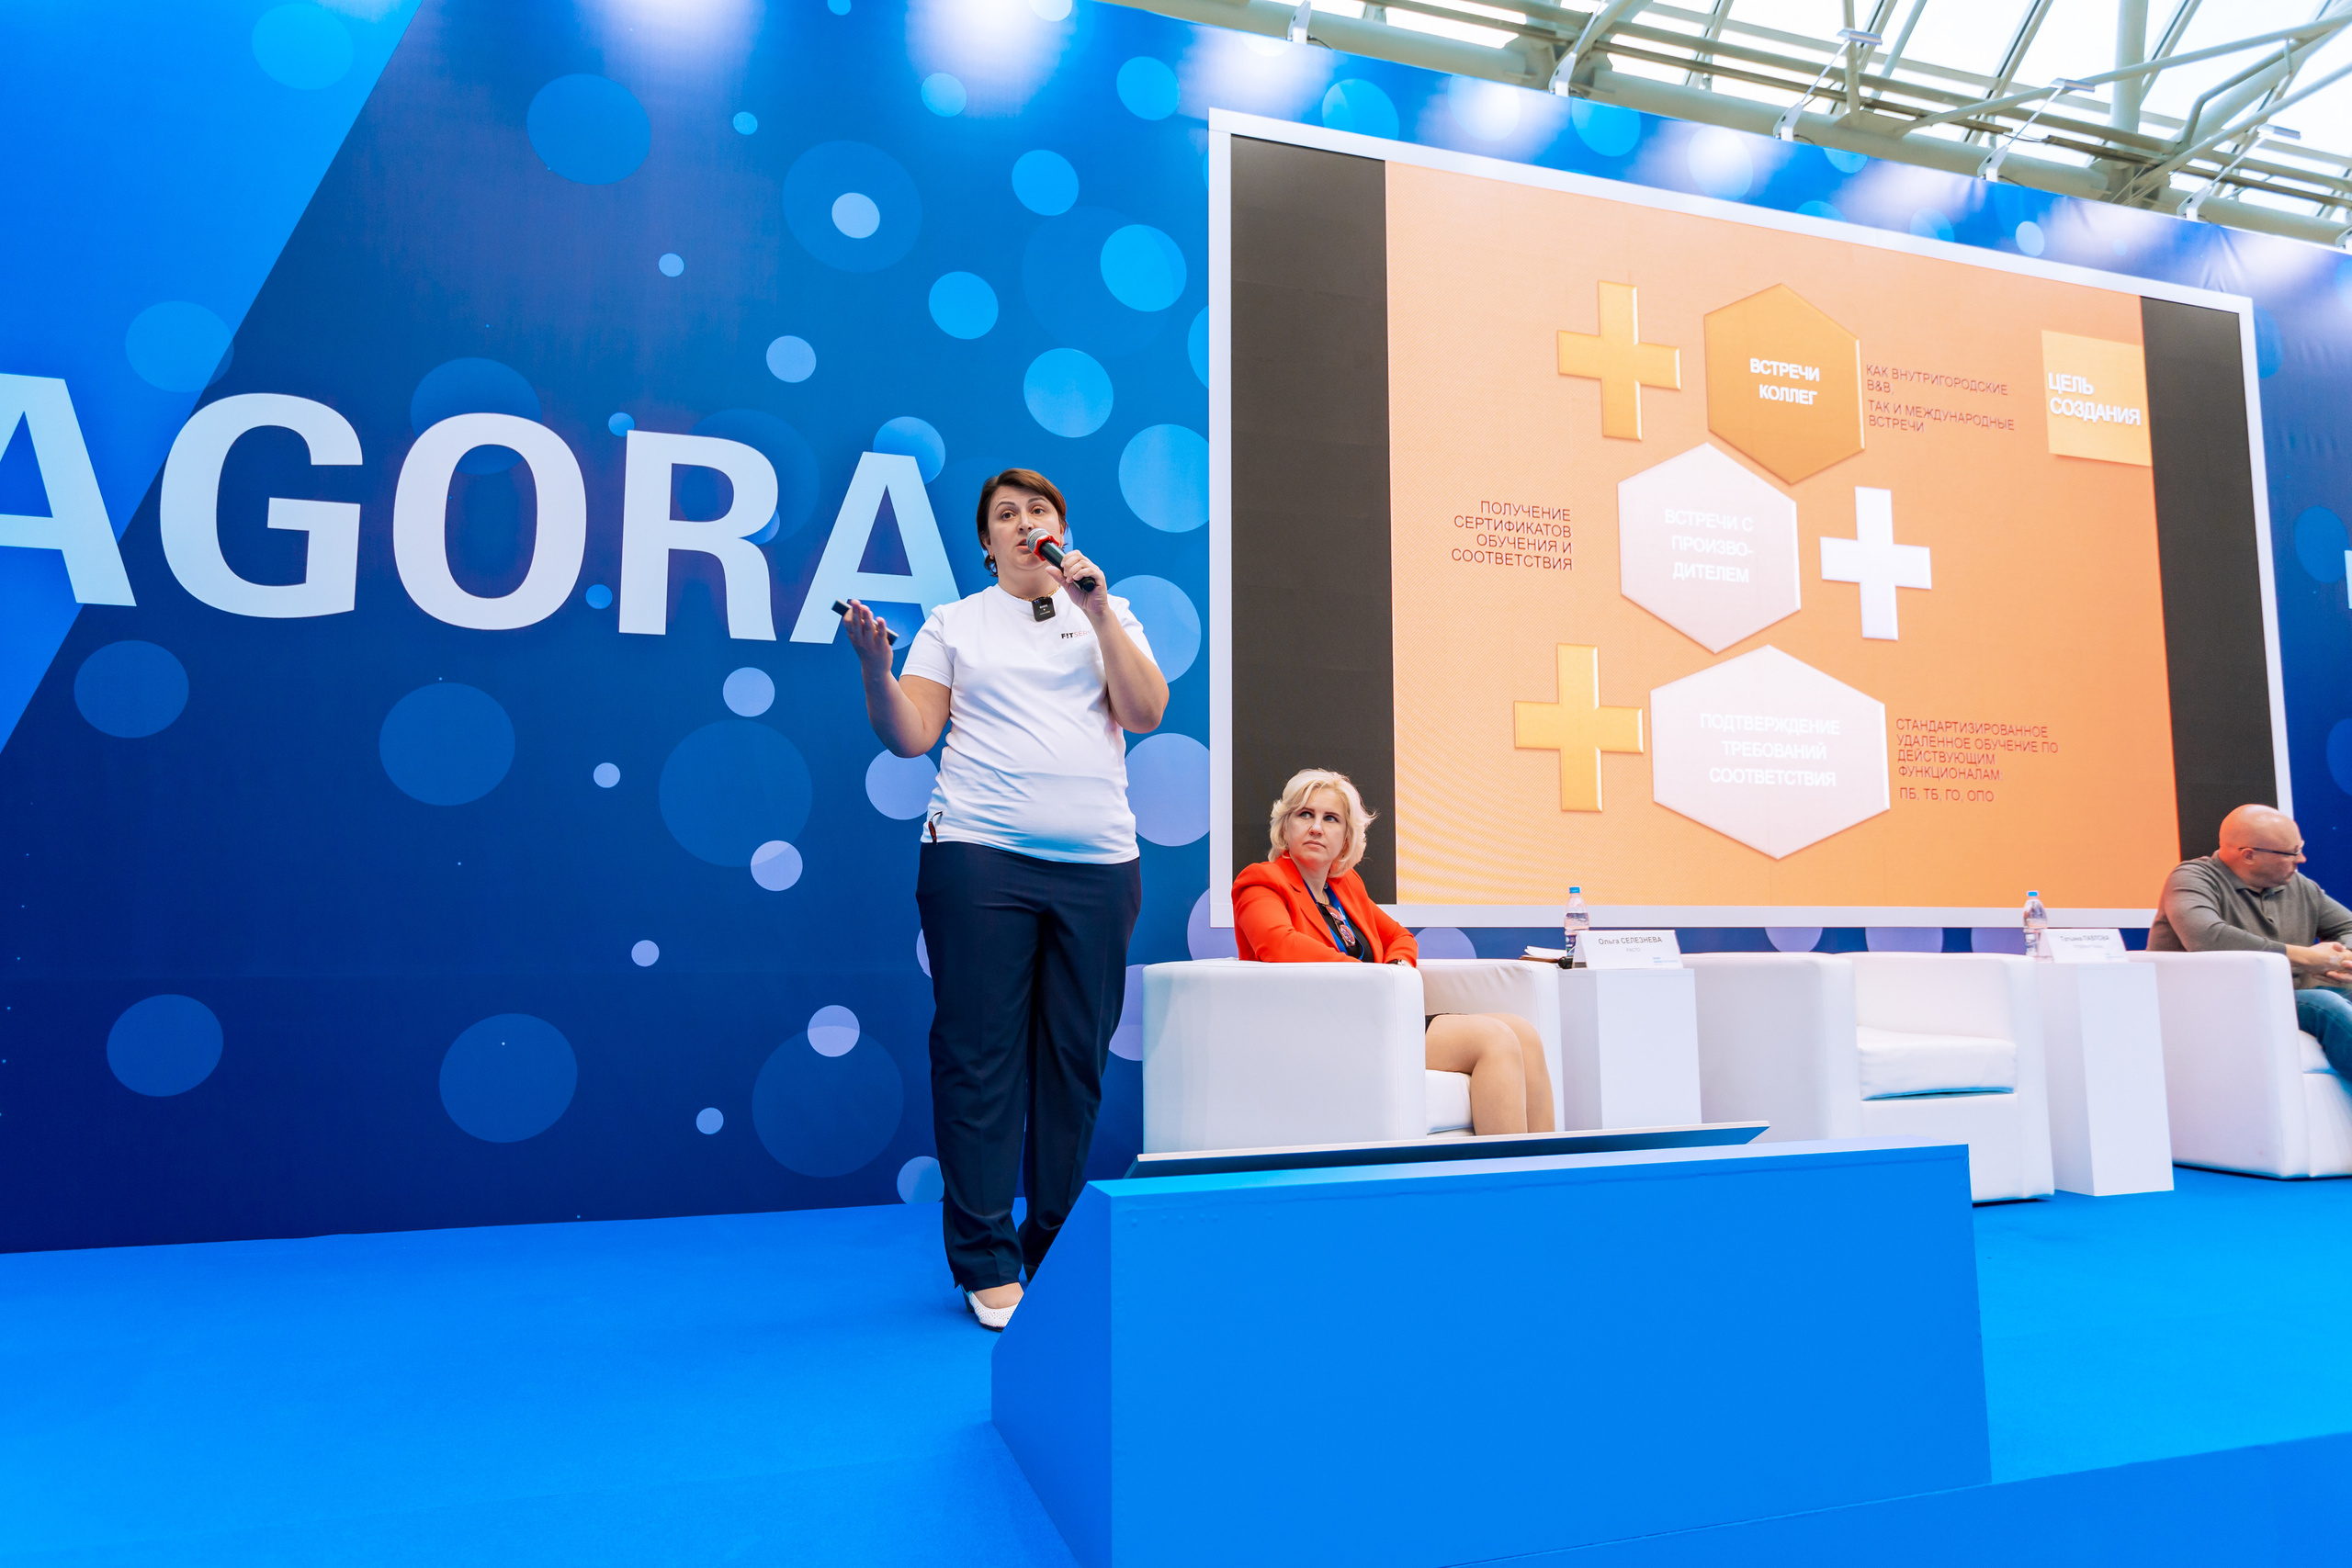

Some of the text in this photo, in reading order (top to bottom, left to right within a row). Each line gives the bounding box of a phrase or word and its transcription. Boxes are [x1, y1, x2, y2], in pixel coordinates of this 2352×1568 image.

[1749, 357, 1820, 382] ВСТРЕЧИ
[1866, 364, 2008, 396] КАК ВНУТРИГОРОДСКИЕ
[1758, 384, 1818, 405] КОЛЛЕГ
[2048, 372, 2095, 395] ЦЕЛЬ
[1868, 400, 2016, 432] ТАК И МЕЖДУНАРОДНЫЕ
[2050, 396, 2142, 426] СОЗДАНИЯ
[1869, 415, 1925, 433] ВСТРЕЧИ
[0, 372, 961, 646] AGORA
[1480, 500, 1571, 522] ПОЛУЧЕНИЕ
[1453, 514, 1572, 538] СЕРТИФИКАТОВ
[1664, 508, 1755, 533] ВСТРЕЧИ С
[1476, 533, 1572, 554] ОБУЧЕНИЯ И
[1671, 535, 1754, 558] ПРОИЗВО-
[1451, 547, 1573, 571] СООТВЕТСТВИЯ
[1672, 561, 1750, 583] ДИТЕЛЕМ
[1700, 713, 1841, 737] ПОДТВЕРЖДЕНИЕ
[1895, 717, 2049, 739] СТАНДАРТИЗИРОВАННОЕ
[1721, 739, 1827, 761] ТРЕБОВАНИЙ
[1896, 734, 2060, 754] УДАЛЕННОЕ ОБУЧЕНИЕ ПО
[1897, 748, 1996, 767] ДЕЙСТВУЮЩИМ
[1709, 767, 1838, 788] СООТВЕТСТВИЯ
[1899, 787, 1920, 801] ПБ,
[1966, 790, 1995, 802] ОПО
[1621, 936, 1662, 944] СЕЛЕЗНЕВА
